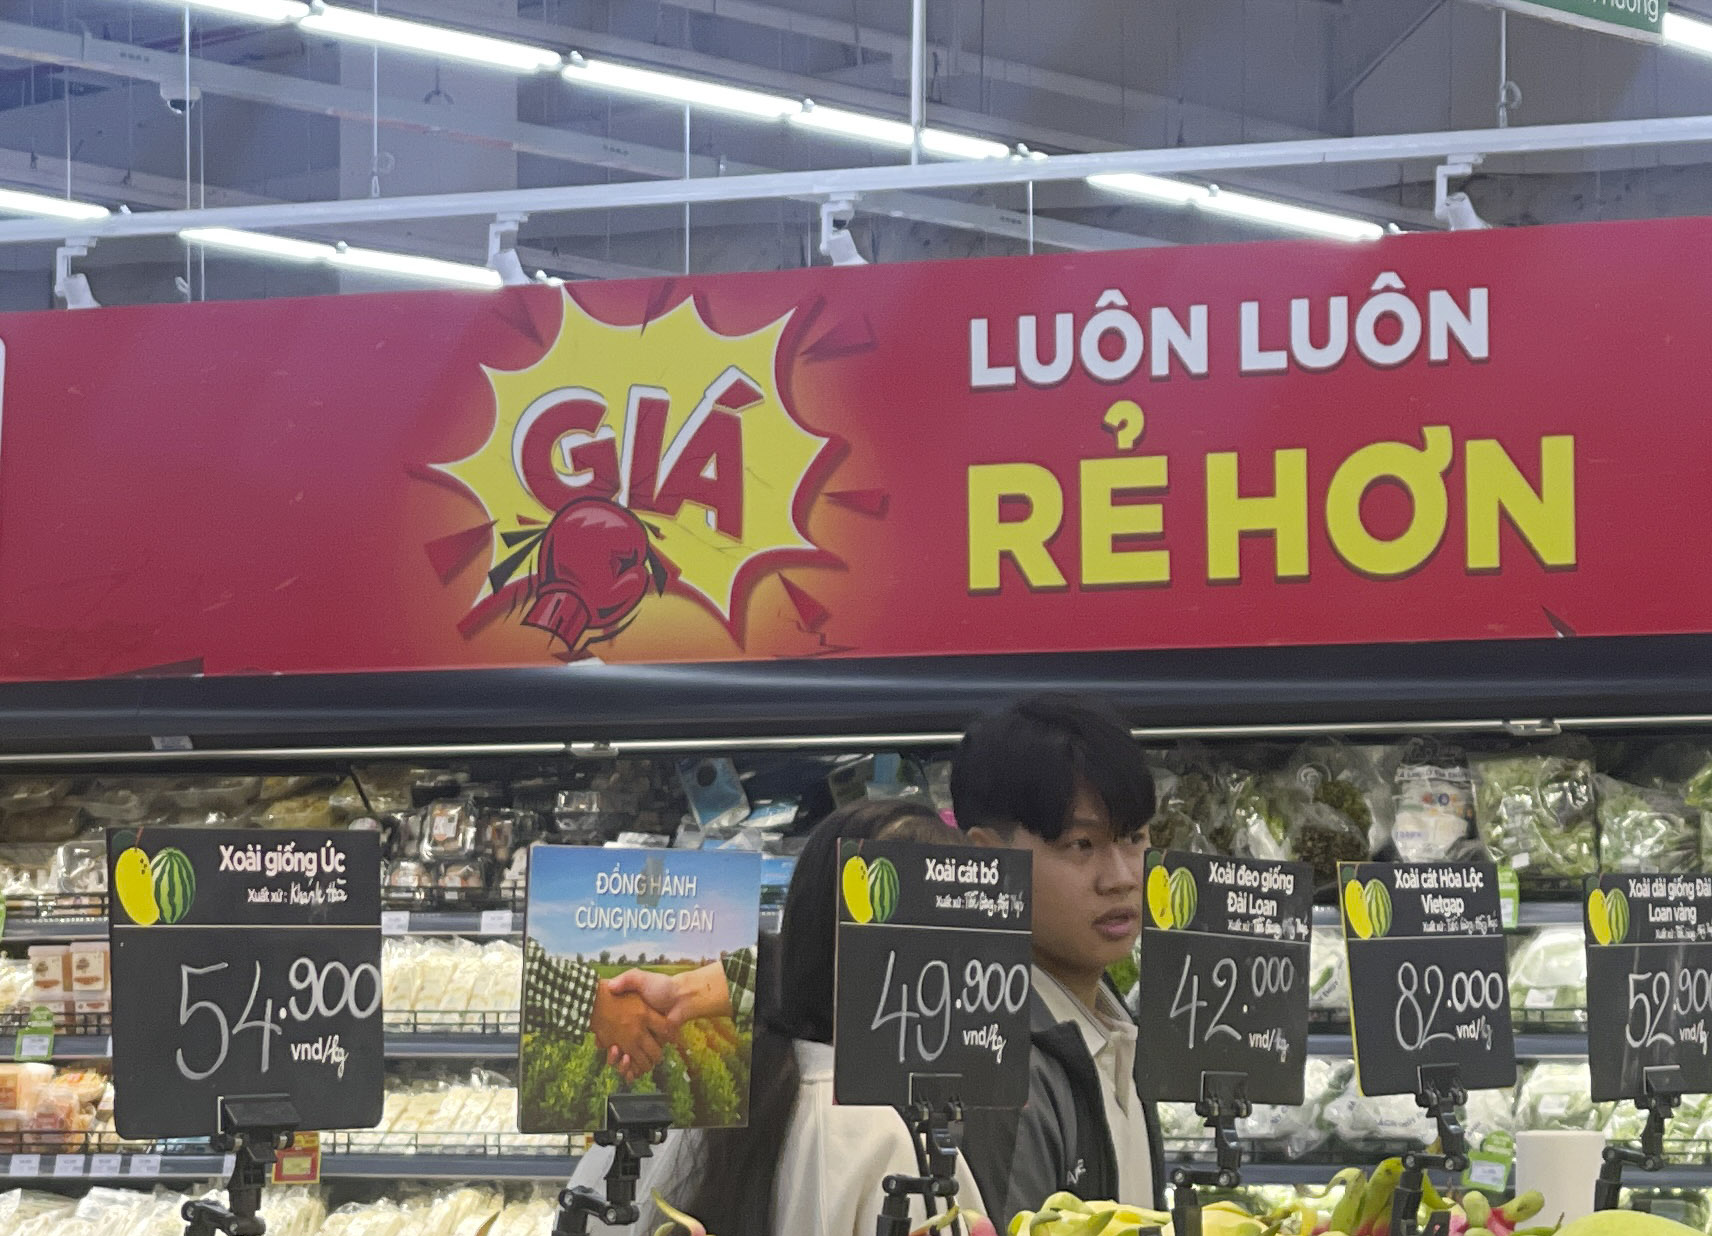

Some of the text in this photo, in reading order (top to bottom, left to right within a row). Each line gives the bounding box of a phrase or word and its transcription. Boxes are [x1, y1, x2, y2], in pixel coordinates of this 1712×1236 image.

[969, 272, 1489, 388] LUÔN LUÔN
[512, 365, 764, 543] GIÁ
[968, 400, 1577, 591] RẺ HƠN
[219, 840, 346, 877] Xoài giống Úc
[925, 858, 955, 881] Xoài
[957, 860, 978, 883] cát
[596, 862, 697, 896] ĐỒNG HÀNH
[1209, 861, 1235, 885] Xoài
[1261, 865, 1294, 895] giống
[1394, 866, 1484, 893] Xoài cát Hòa Lộc
[1628, 877, 1650, 897] Xoài
[1668, 875, 1695, 901] giống
[1696, 877, 1712, 897] Đài
[575, 901, 714, 931] CÙNG NÔNG DÂN
[1227, 891, 1277, 917] Đài Loan
[1421, 893, 1465, 917] Vietgap
[1648, 902, 1697, 925] Loan vàng
[176, 957, 382, 1080] 54.900
[871, 950, 1029, 1064] 49.900
[1170, 954, 1294, 1049] 42.000
[1395, 962, 1503, 1050] 82.000
[290, 1034, 349, 1079] vnd/kg
[962, 1023, 1007, 1064] vnd/kg
